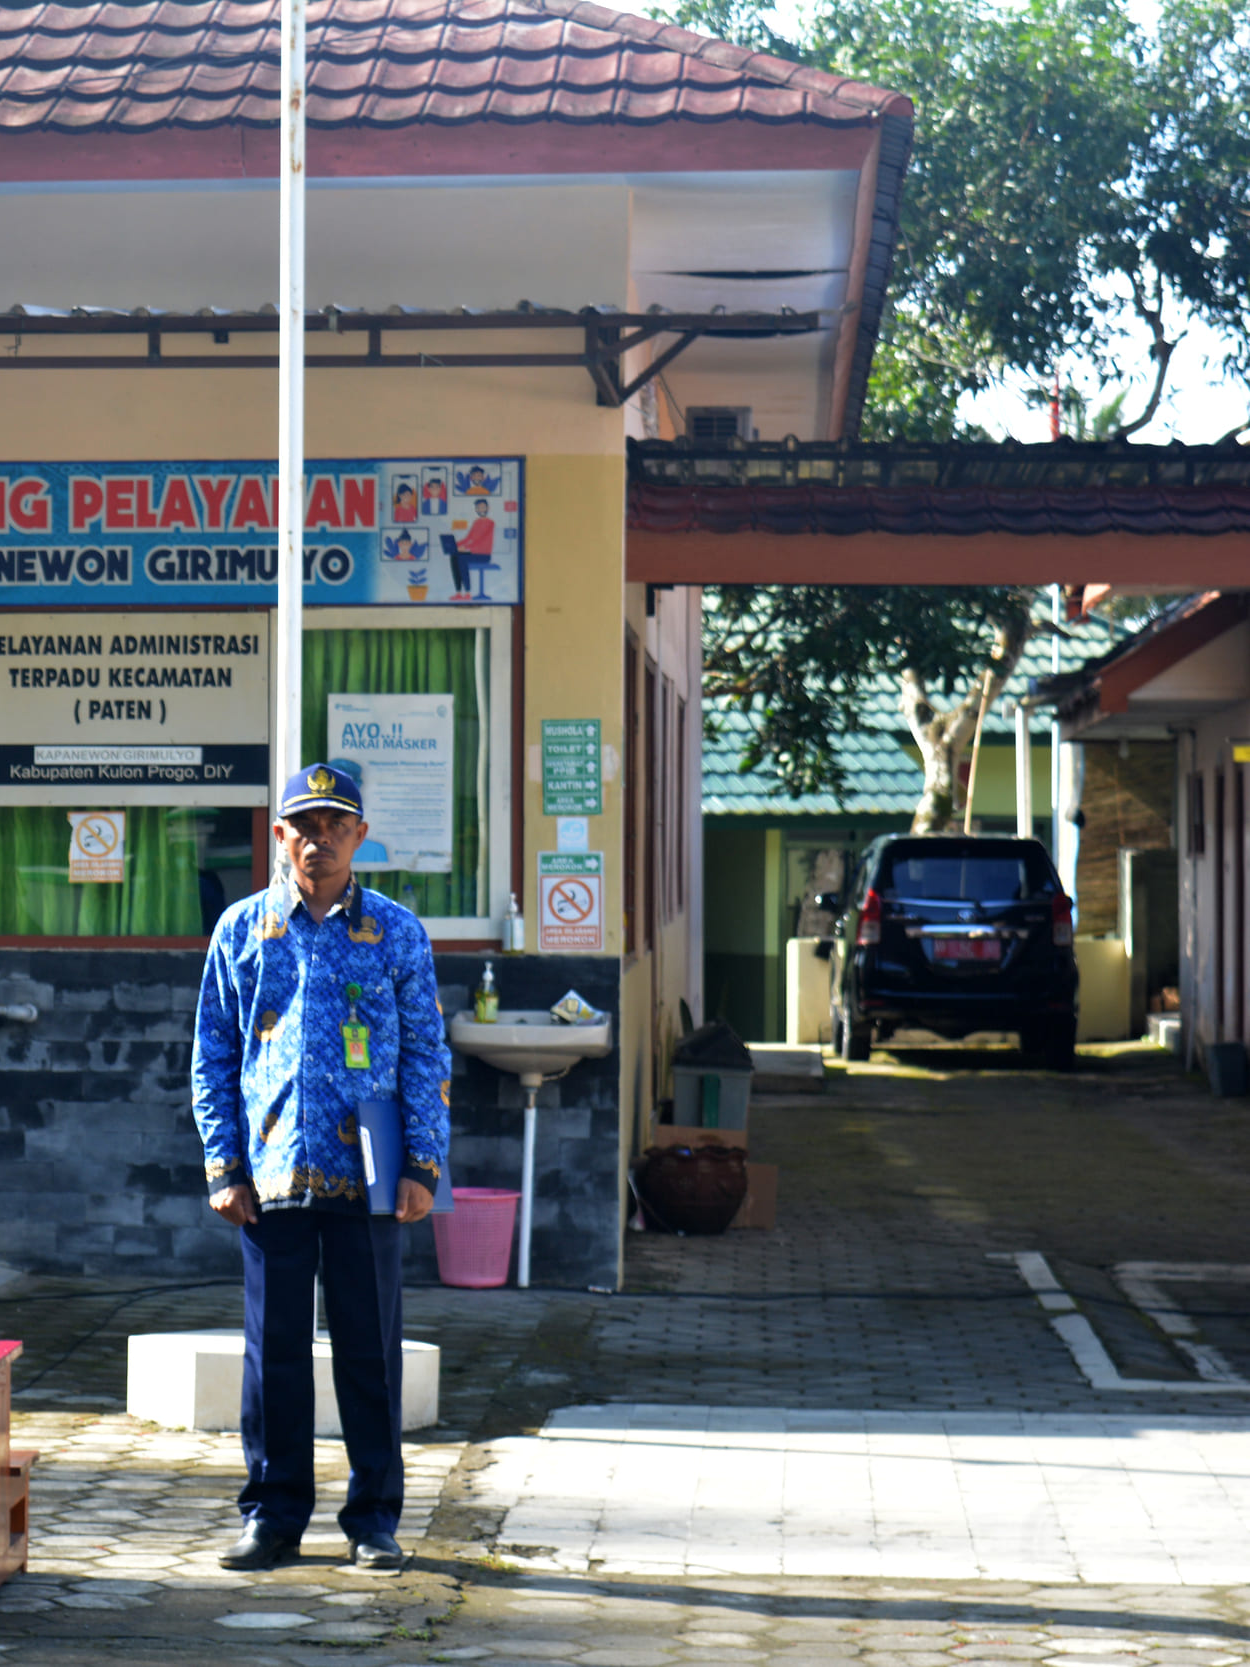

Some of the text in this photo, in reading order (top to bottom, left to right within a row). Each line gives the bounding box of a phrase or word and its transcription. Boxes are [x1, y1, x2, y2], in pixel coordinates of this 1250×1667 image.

[70, 476, 378, 532] PELAYAAN
[146, 548, 353, 583] GIRIMUYO
[109, 635, 259, 656] ADMINISTRASI
[9, 667, 232, 688] TERPADU KECAMATAN
[341, 738, 438, 750] PAKAI MASKER
[547, 744, 583, 753] TOILET
[35, 750, 196, 761] KAPANEWON GIRIMULYO
[10, 764, 234, 782] Kabupaten Kulon Progo, DIY
[547, 781, 583, 791] KANTIN
